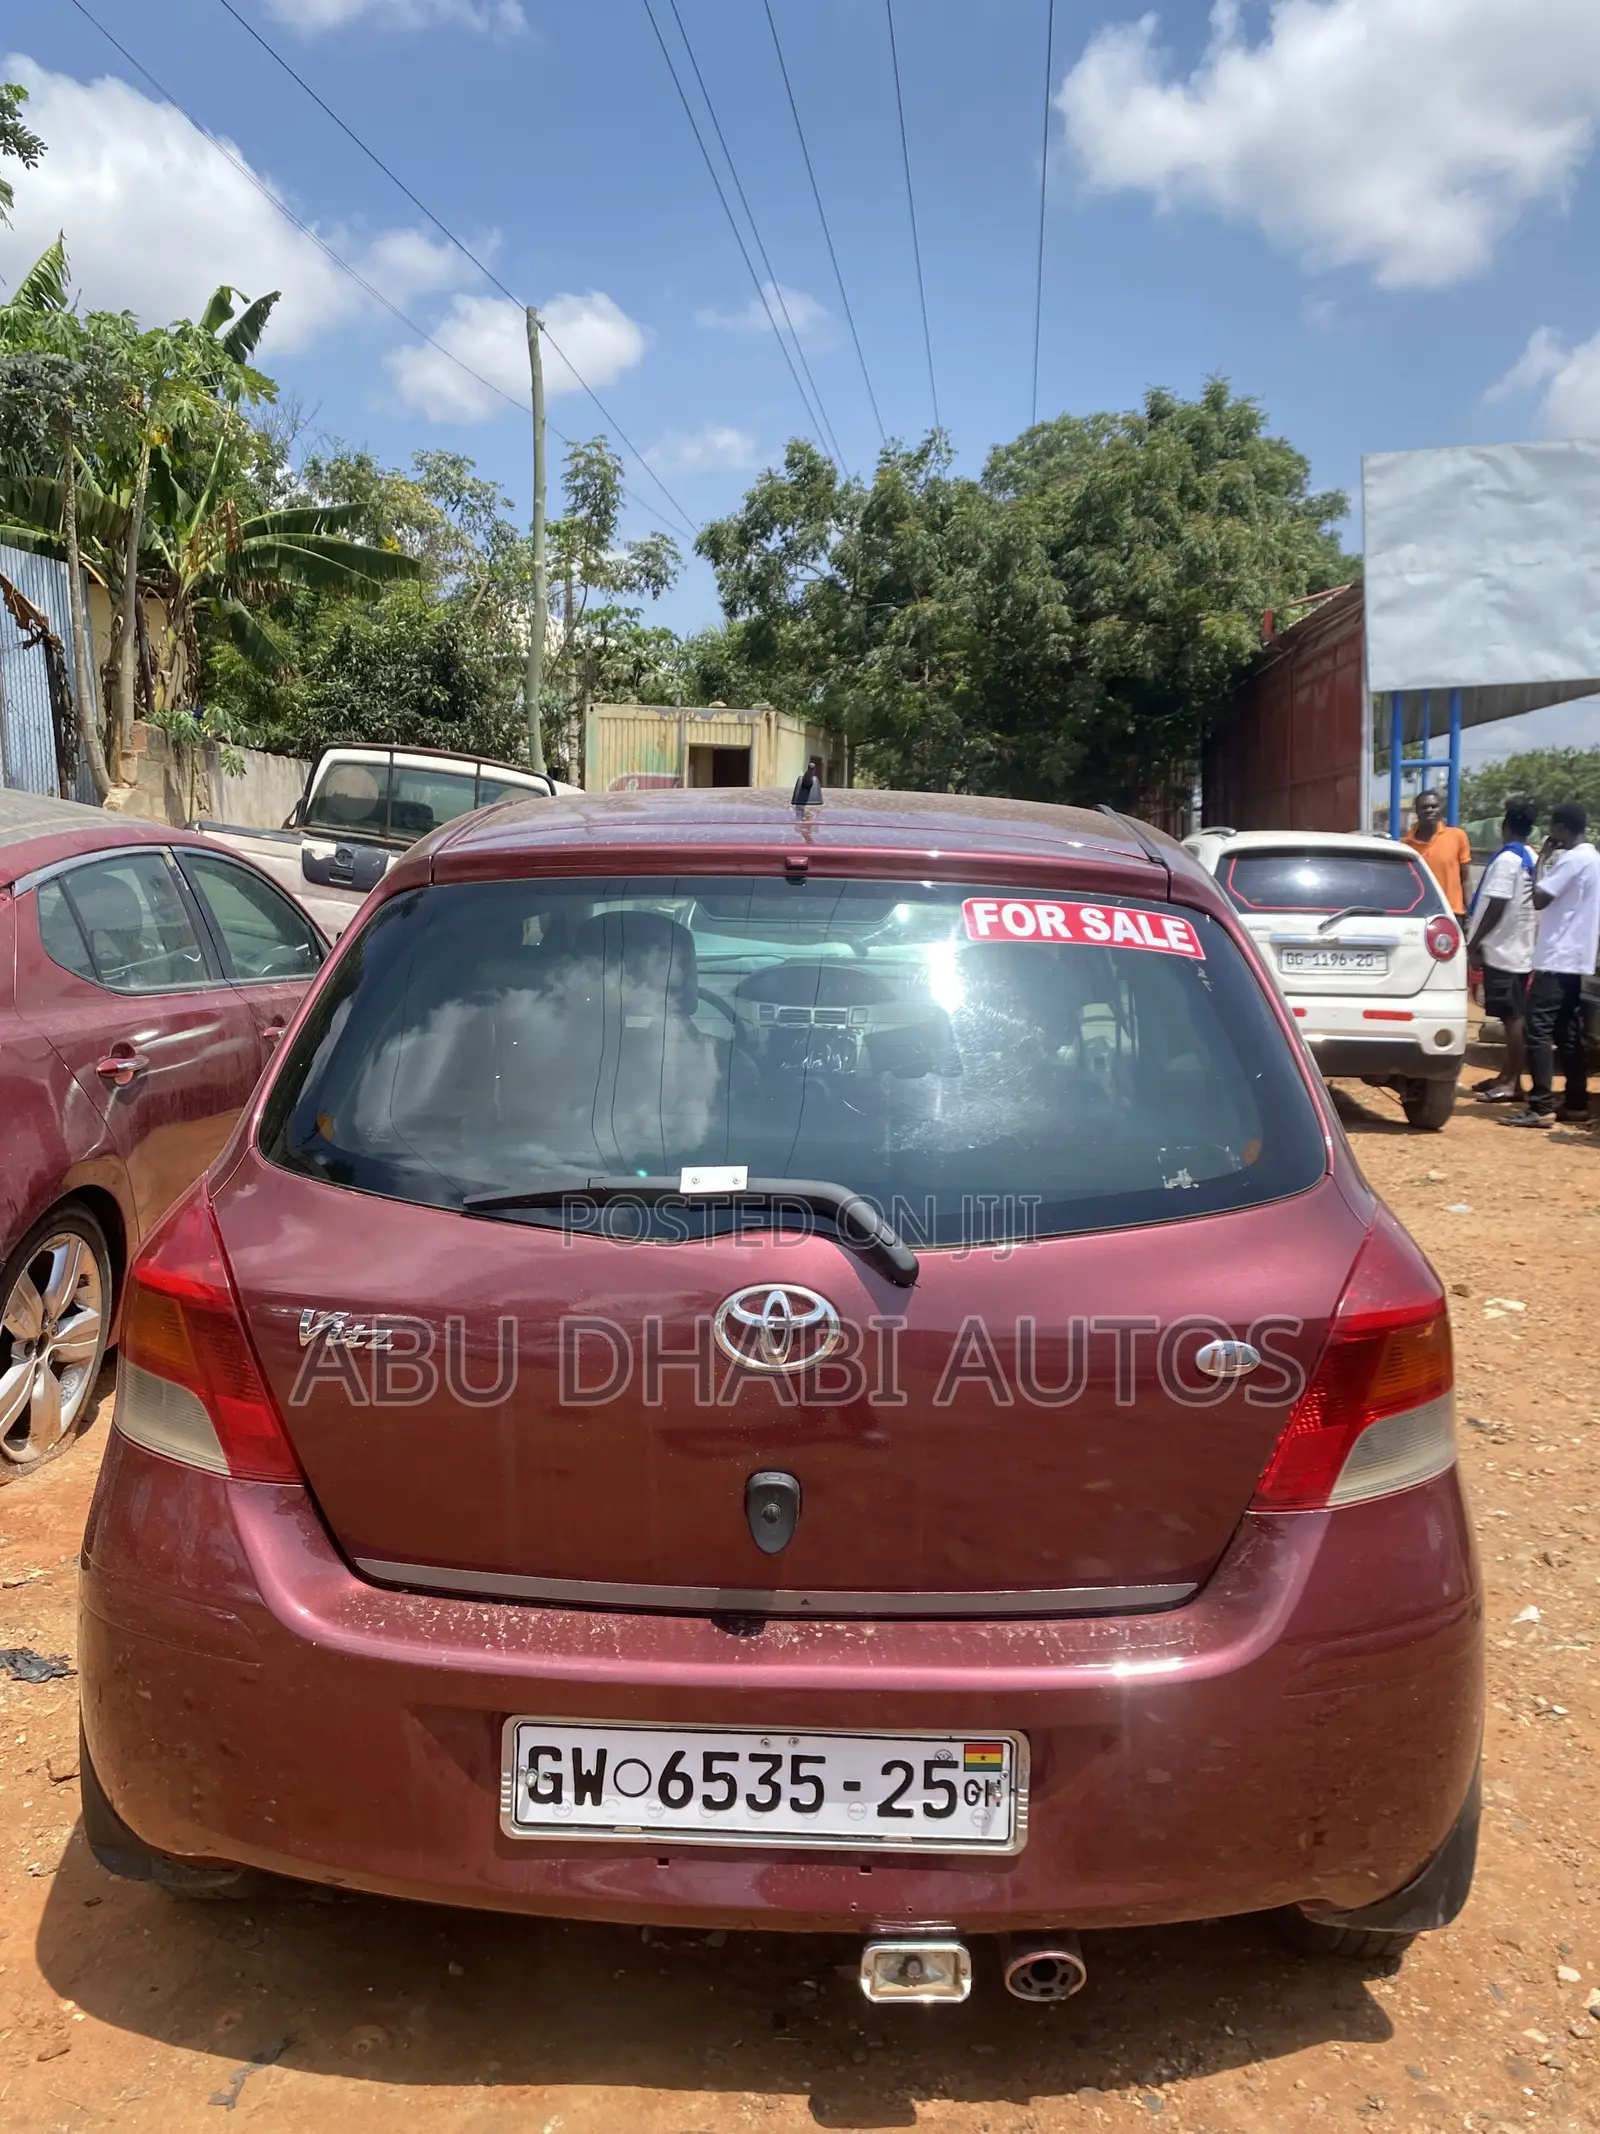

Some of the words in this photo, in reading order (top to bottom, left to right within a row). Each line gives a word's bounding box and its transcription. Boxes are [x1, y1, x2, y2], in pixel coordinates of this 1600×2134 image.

[972, 902, 1072, 938] FOR
[1079, 907, 1196, 953] SALE
[299, 1308, 394, 1350] Vitz
[527, 1745, 606, 1806] GW
